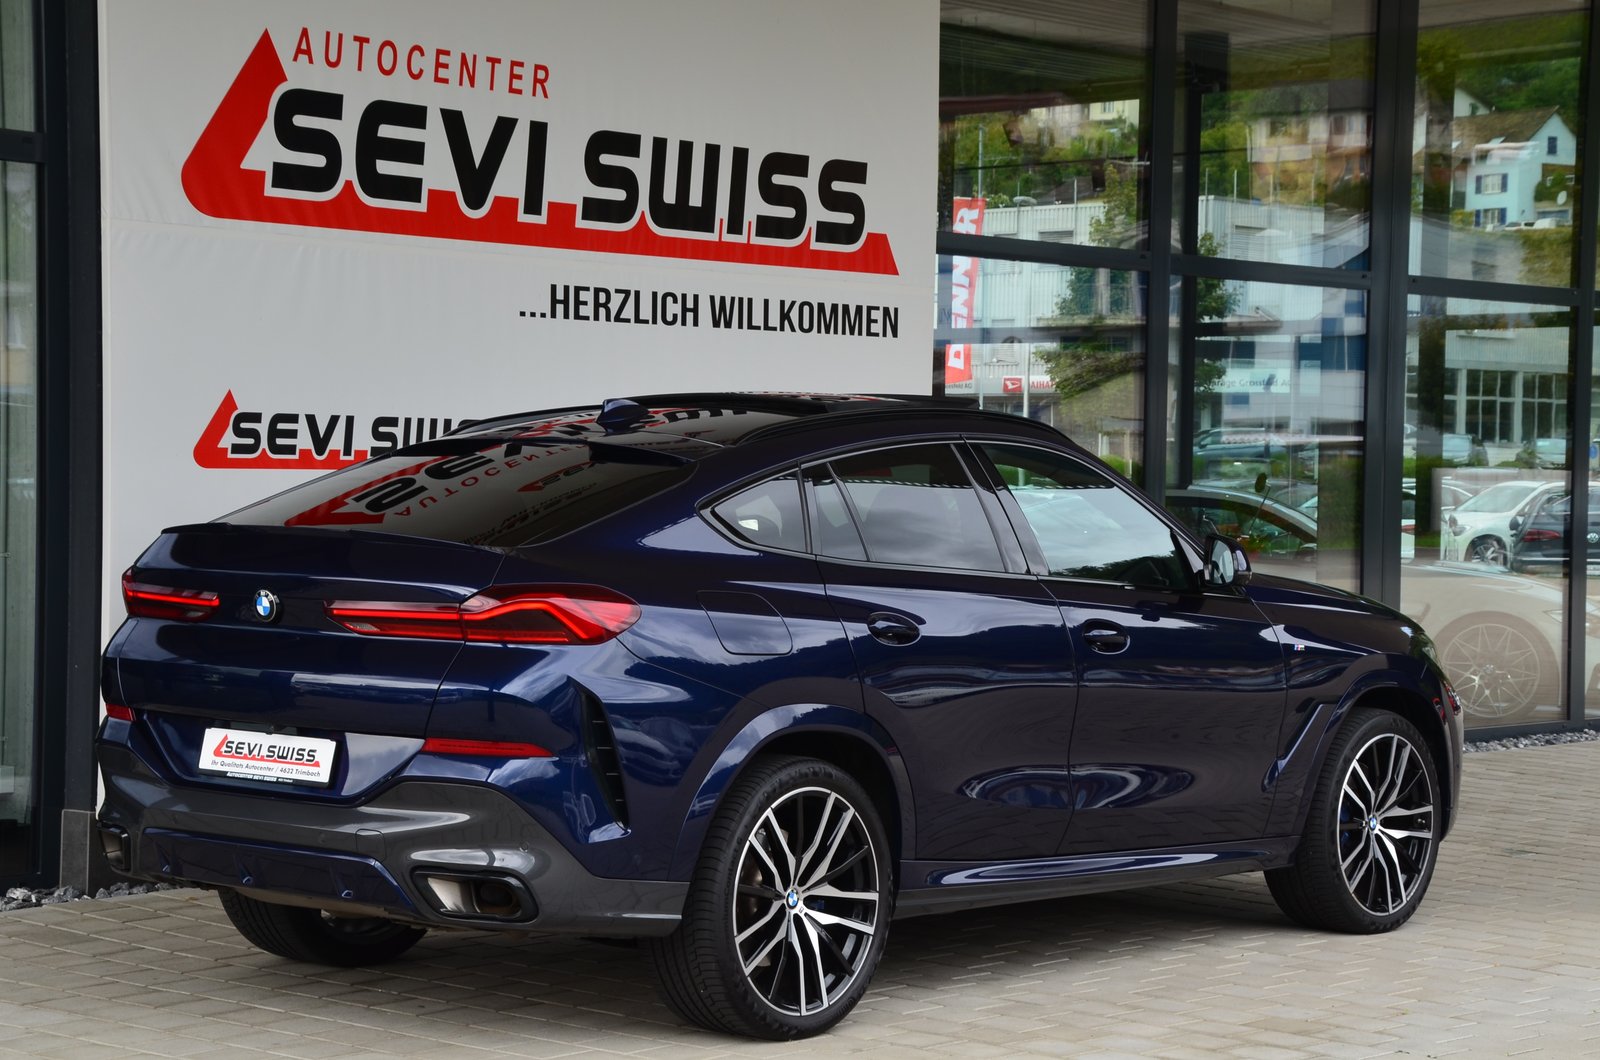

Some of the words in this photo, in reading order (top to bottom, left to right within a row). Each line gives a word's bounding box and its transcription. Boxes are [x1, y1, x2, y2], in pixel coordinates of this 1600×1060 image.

[292, 26, 550, 99] AUTOCENTER
[271, 88, 548, 215] SEVI
[582, 129, 868, 246] SWISS
[709, 295, 900, 339] WILLKOMMEN
[230, 411, 355, 457] SEVI
[223, 740, 263, 757] SEVI
[266, 744, 318, 763] SWISS
[245, 763, 274, 772] Autocenter
[295, 768, 321, 777] Trimbach
